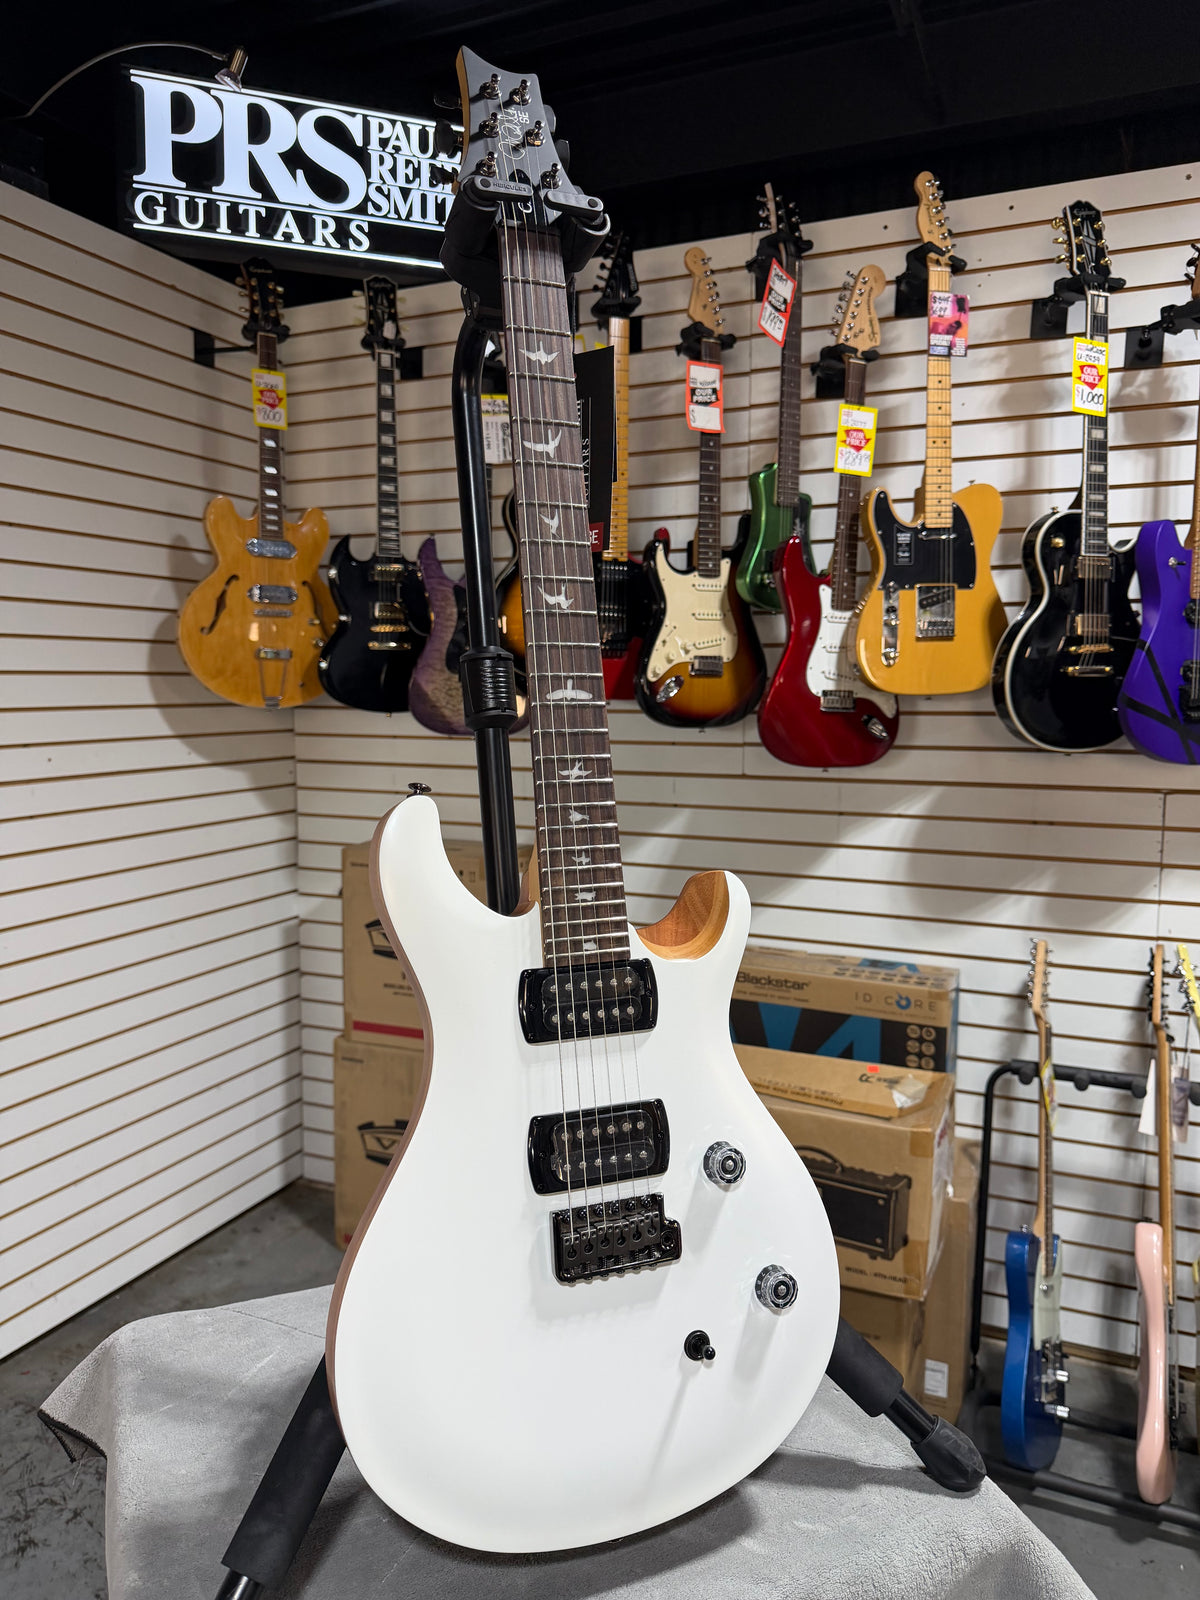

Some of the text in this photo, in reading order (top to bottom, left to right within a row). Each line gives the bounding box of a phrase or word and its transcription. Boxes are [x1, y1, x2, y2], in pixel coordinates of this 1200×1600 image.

[519, 111, 530, 124] SE
[131, 76, 368, 212] PRS
[367, 182, 456, 225] SMIT
[134, 192, 370, 252] GUITARS
[1083, 365, 1098, 376] OUR
[1080, 373, 1101, 385] PRICE
[694, 388, 713, 396] OUR
[692, 395, 717, 403] PRICE
[849, 429, 865, 439] OUR
[845, 437, 867, 447] PRICE
[737, 971, 809, 990] Blackstar
